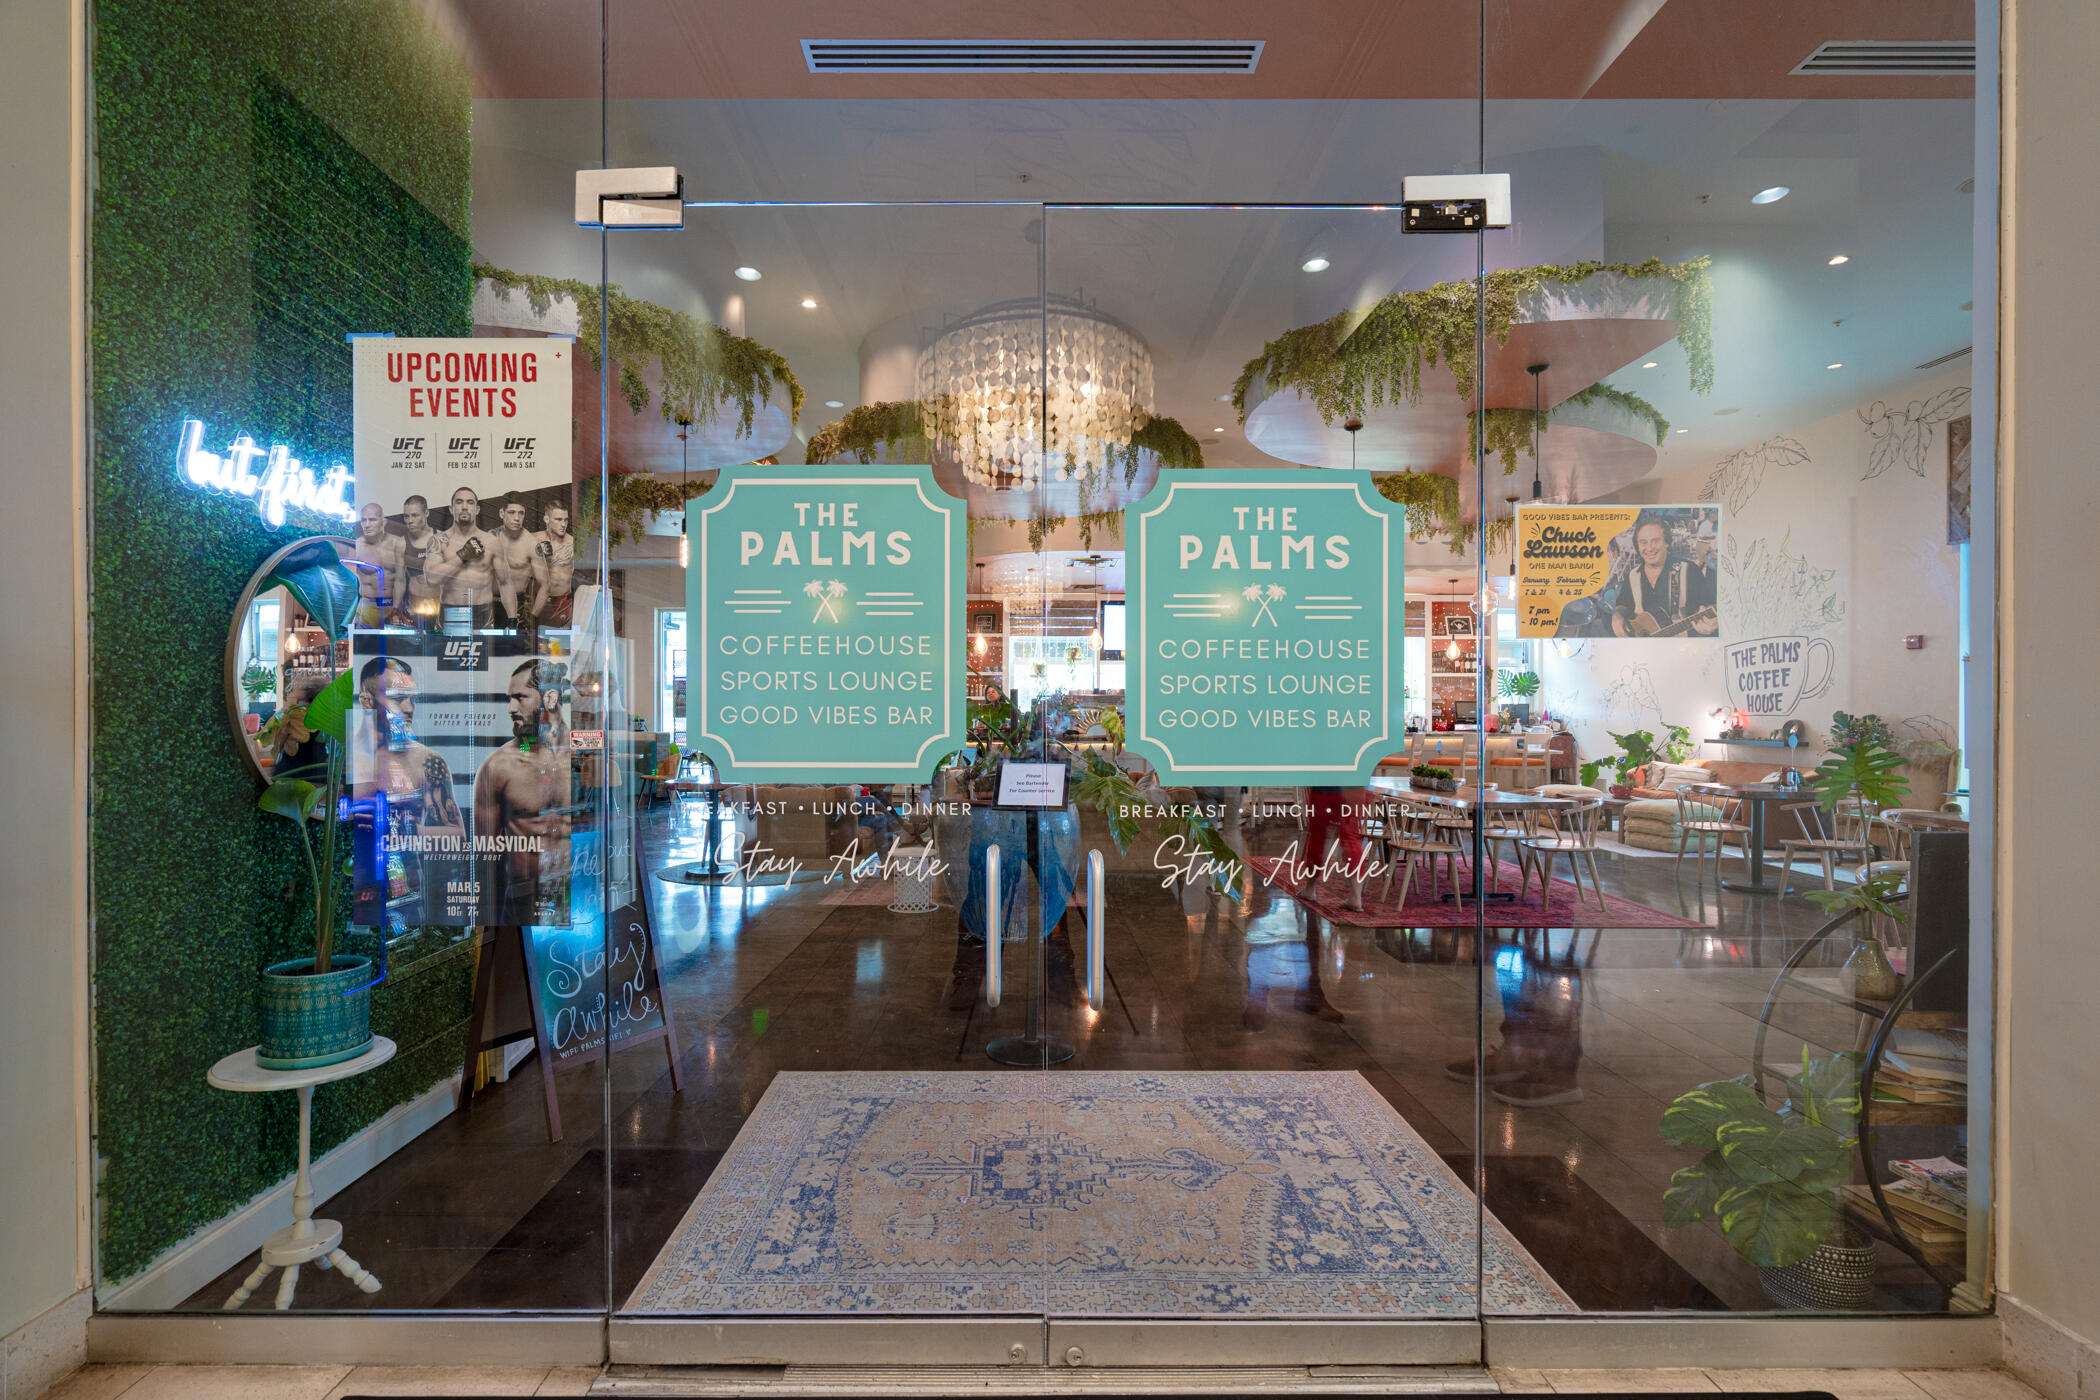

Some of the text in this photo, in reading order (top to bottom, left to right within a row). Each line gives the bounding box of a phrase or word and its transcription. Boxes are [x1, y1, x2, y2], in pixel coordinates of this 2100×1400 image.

[387, 352, 537, 383] UPCOMING
[410, 388, 516, 417] EVENTS
[392, 438, 425, 450] UFC
[448, 438, 480, 450] UFC
[504, 438, 536, 450] UFC
[405, 451, 422, 459] 270
[464, 451, 477, 459] 271
[517, 451, 533, 459] 272
[392, 461, 425, 469] JAN 22 SAT
[448, 461, 480, 469] FEB 12 SAT
[504, 461, 535, 469] MAR 5 SAT
[794, 503, 858, 527] THE
[1233, 507, 1297, 531] THE
[1541, 526, 1596, 543] Chuck
[740, 530, 912, 566] PALMS
[1180, 535, 1350, 570] PALMS
[1523, 540, 1604, 558] Lawson
[1522, 576, 1587, 585] January February
[1529, 606, 1550, 616] 7 pm
[1529, 617, 1538, 626] 10
[1540, 617, 1558, 627] pm!
[444, 641, 483, 656] UFC
[720, 635, 931, 656] COFFEEHOUSE
[1159, 639, 1369, 659] COFFEEHOUSE
[1731, 641, 1801, 668] THE PALMS
[460, 657, 479, 667] 272
[720, 671, 933, 691] SPORTS LOUNGE
[1159, 675, 1371, 694] SPORTS LOUNGE
[1739, 668, 1791, 692] COFFEE
[1746, 692, 1783, 713] HOUSE
[720, 706, 933, 725] GOOD VIBES BAR
[1159, 709, 1371, 728] GOOD VIBES BAR
[679, 801, 972, 816] BREAKFAST LUNCH DINNER
[1119, 804, 1411, 818] BREAKFAST LUNCH DINNER
[380, 834, 460, 852] COVINGTON
[473, 835, 544, 853] MASVIDAL
[714, 831, 803, 890] Stay
[1153, 834, 1243, 894] Stay
[447, 882, 480, 893] MAR 5
[446, 896, 480, 904] SATURDAY
[547, 922, 647, 998] Stay
